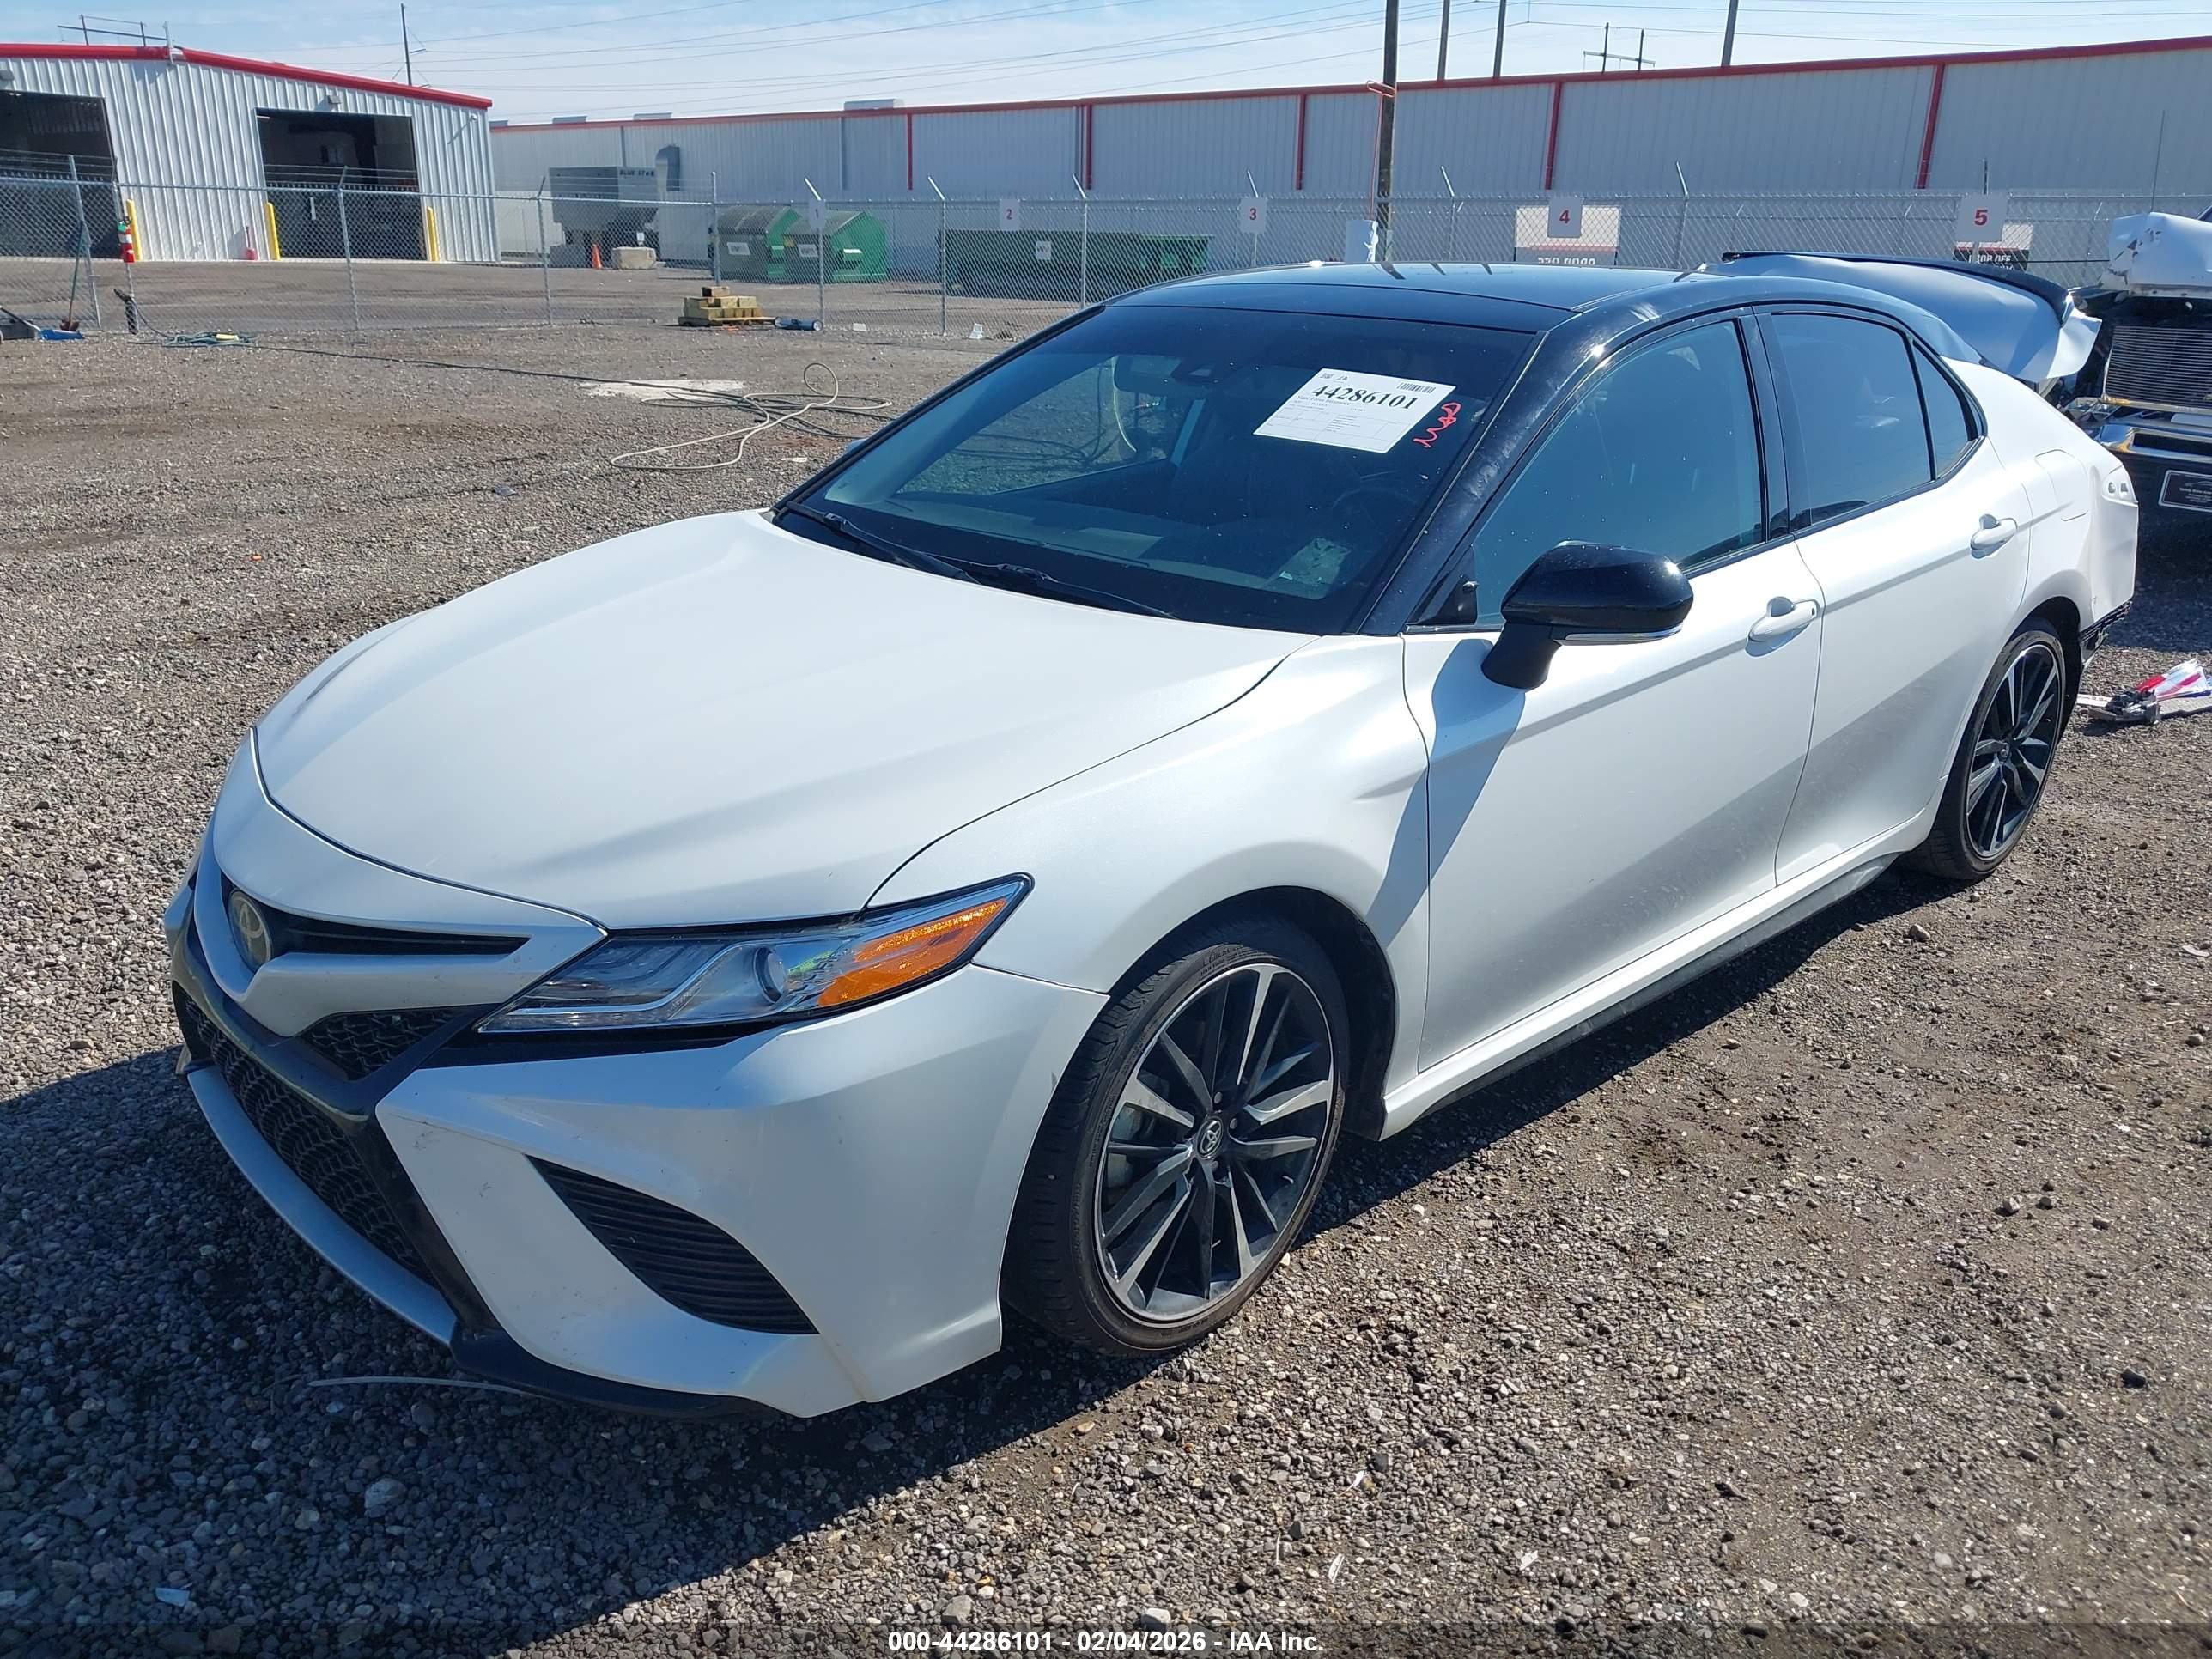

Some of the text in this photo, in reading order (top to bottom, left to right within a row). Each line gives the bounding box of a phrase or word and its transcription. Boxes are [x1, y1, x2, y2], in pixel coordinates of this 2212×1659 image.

[1006, 209, 1013, 220] 2
[1249, 208, 1257, 221] 3
[1559, 210, 1571, 223] 4
[1974, 209, 1988, 226] 5
[1310, 384, 1419, 410] 44286101
